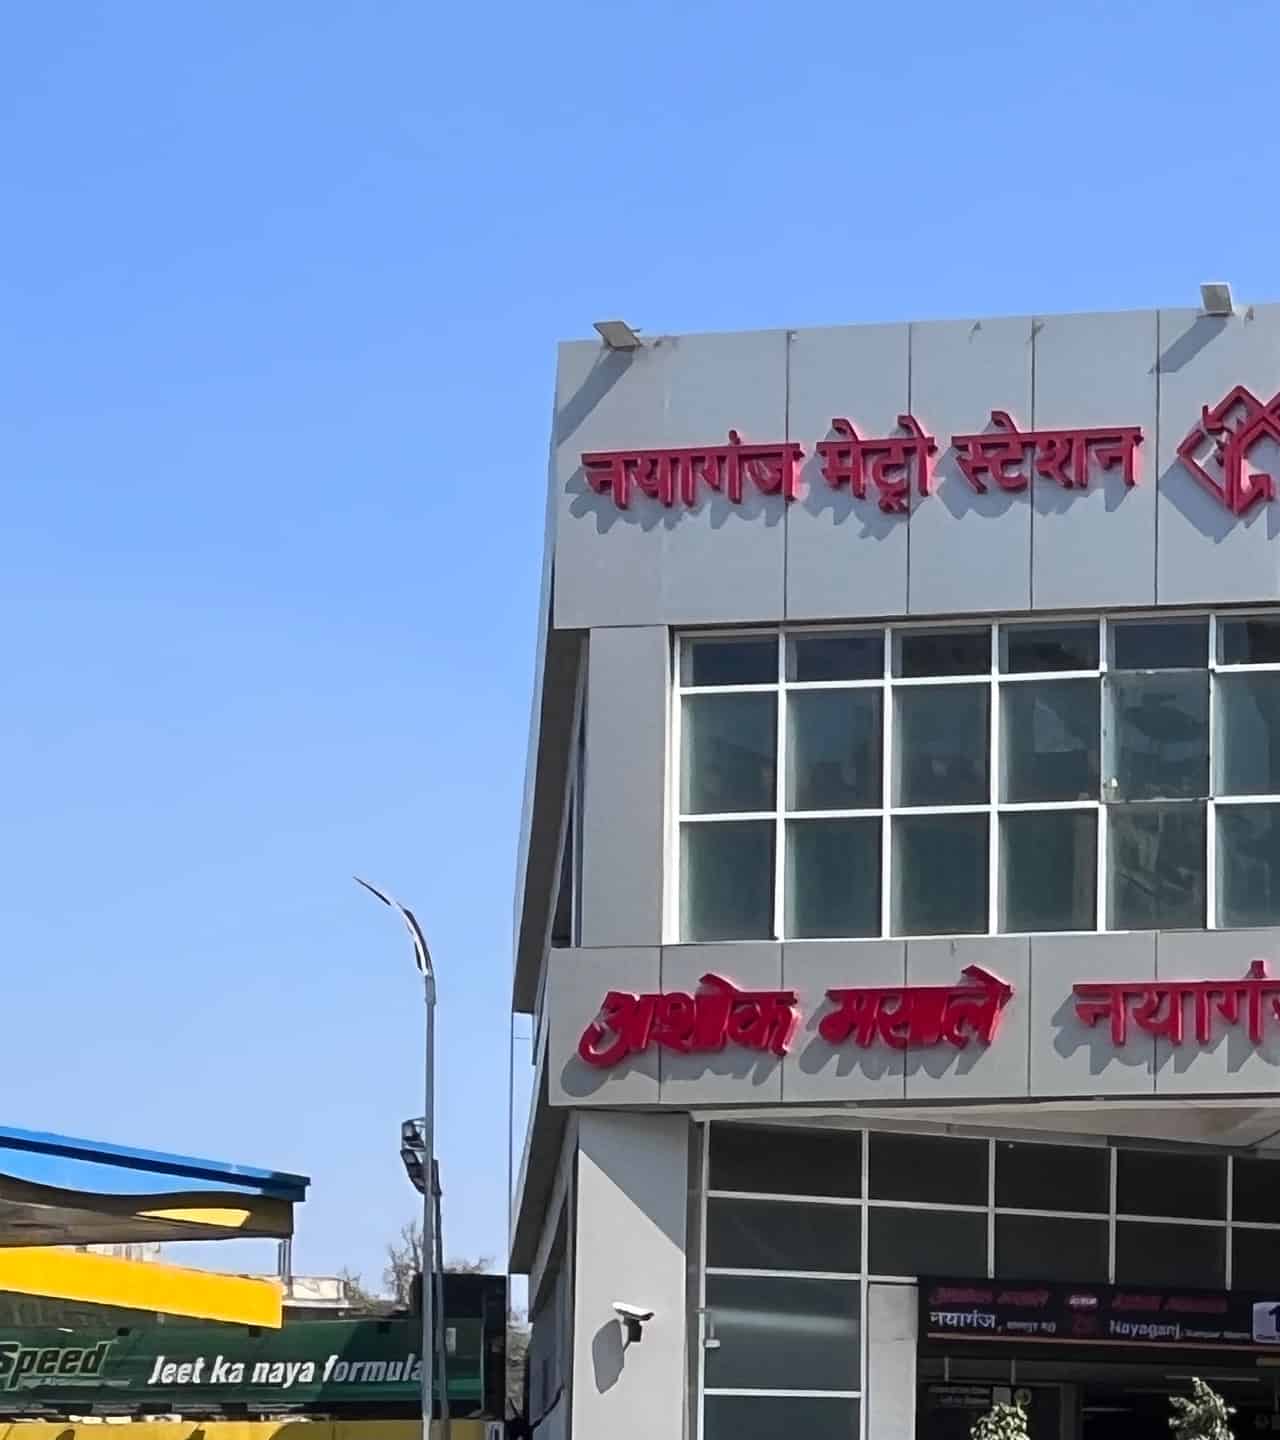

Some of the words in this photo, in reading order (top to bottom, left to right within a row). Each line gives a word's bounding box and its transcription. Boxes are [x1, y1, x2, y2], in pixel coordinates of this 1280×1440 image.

[583, 430, 802, 509] नयागंज
[817, 417, 935, 513] मेट्रो
[951, 411, 1143, 493] स्टेशन
[579, 973, 799, 1066] अशोक
[820, 964, 1013, 1047] मसाले
[0, 1340, 112, 1391] Speed
[148, 1355, 205, 1385] Jeet
[209, 1355, 246, 1384] ka
[251, 1360, 315, 1389] naya
